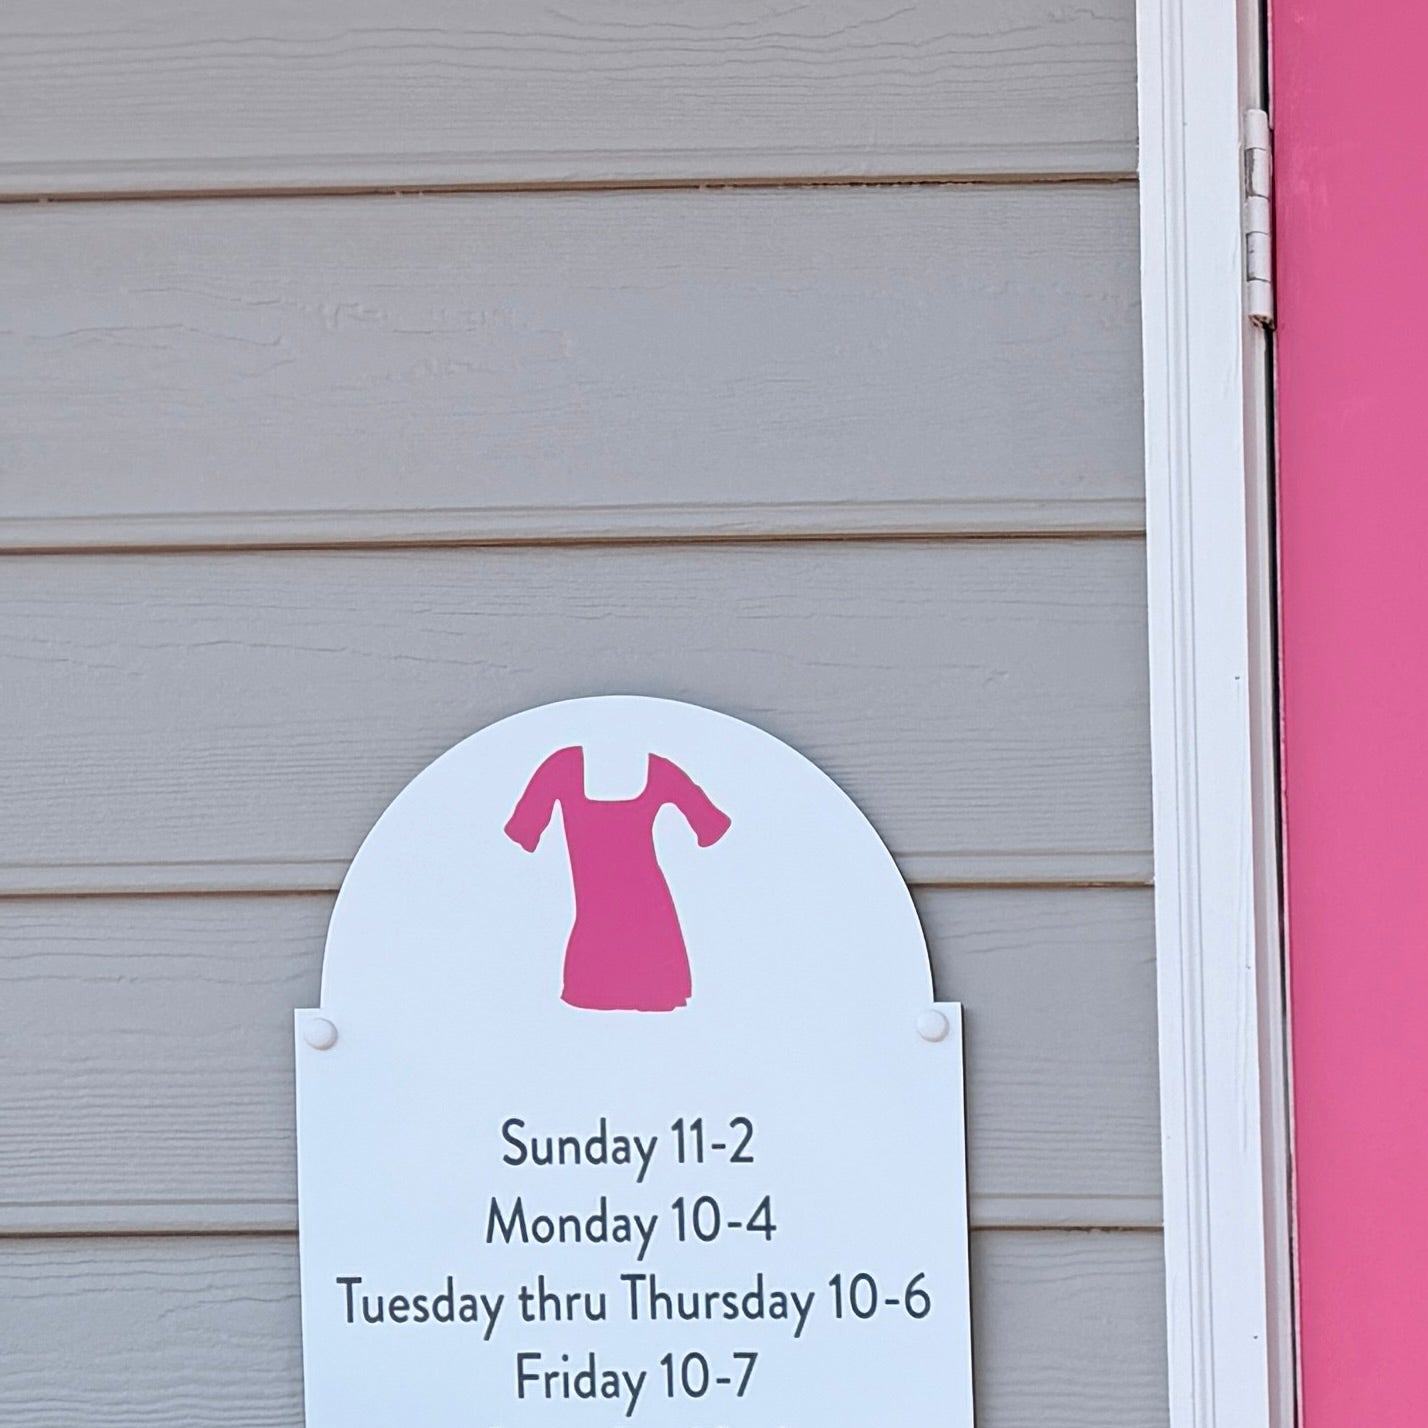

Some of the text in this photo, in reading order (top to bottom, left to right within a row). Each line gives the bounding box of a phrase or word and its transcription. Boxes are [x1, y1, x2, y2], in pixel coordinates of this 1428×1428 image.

[502, 1117, 755, 1183] Sunday 11-2
[486, 1196, 777, 1261] Monday 10-4
[336, 1273, 931, 1341] Tuesday thru Thursday 10-6
[516, 1352, 759, 1417] Friday 10-7
